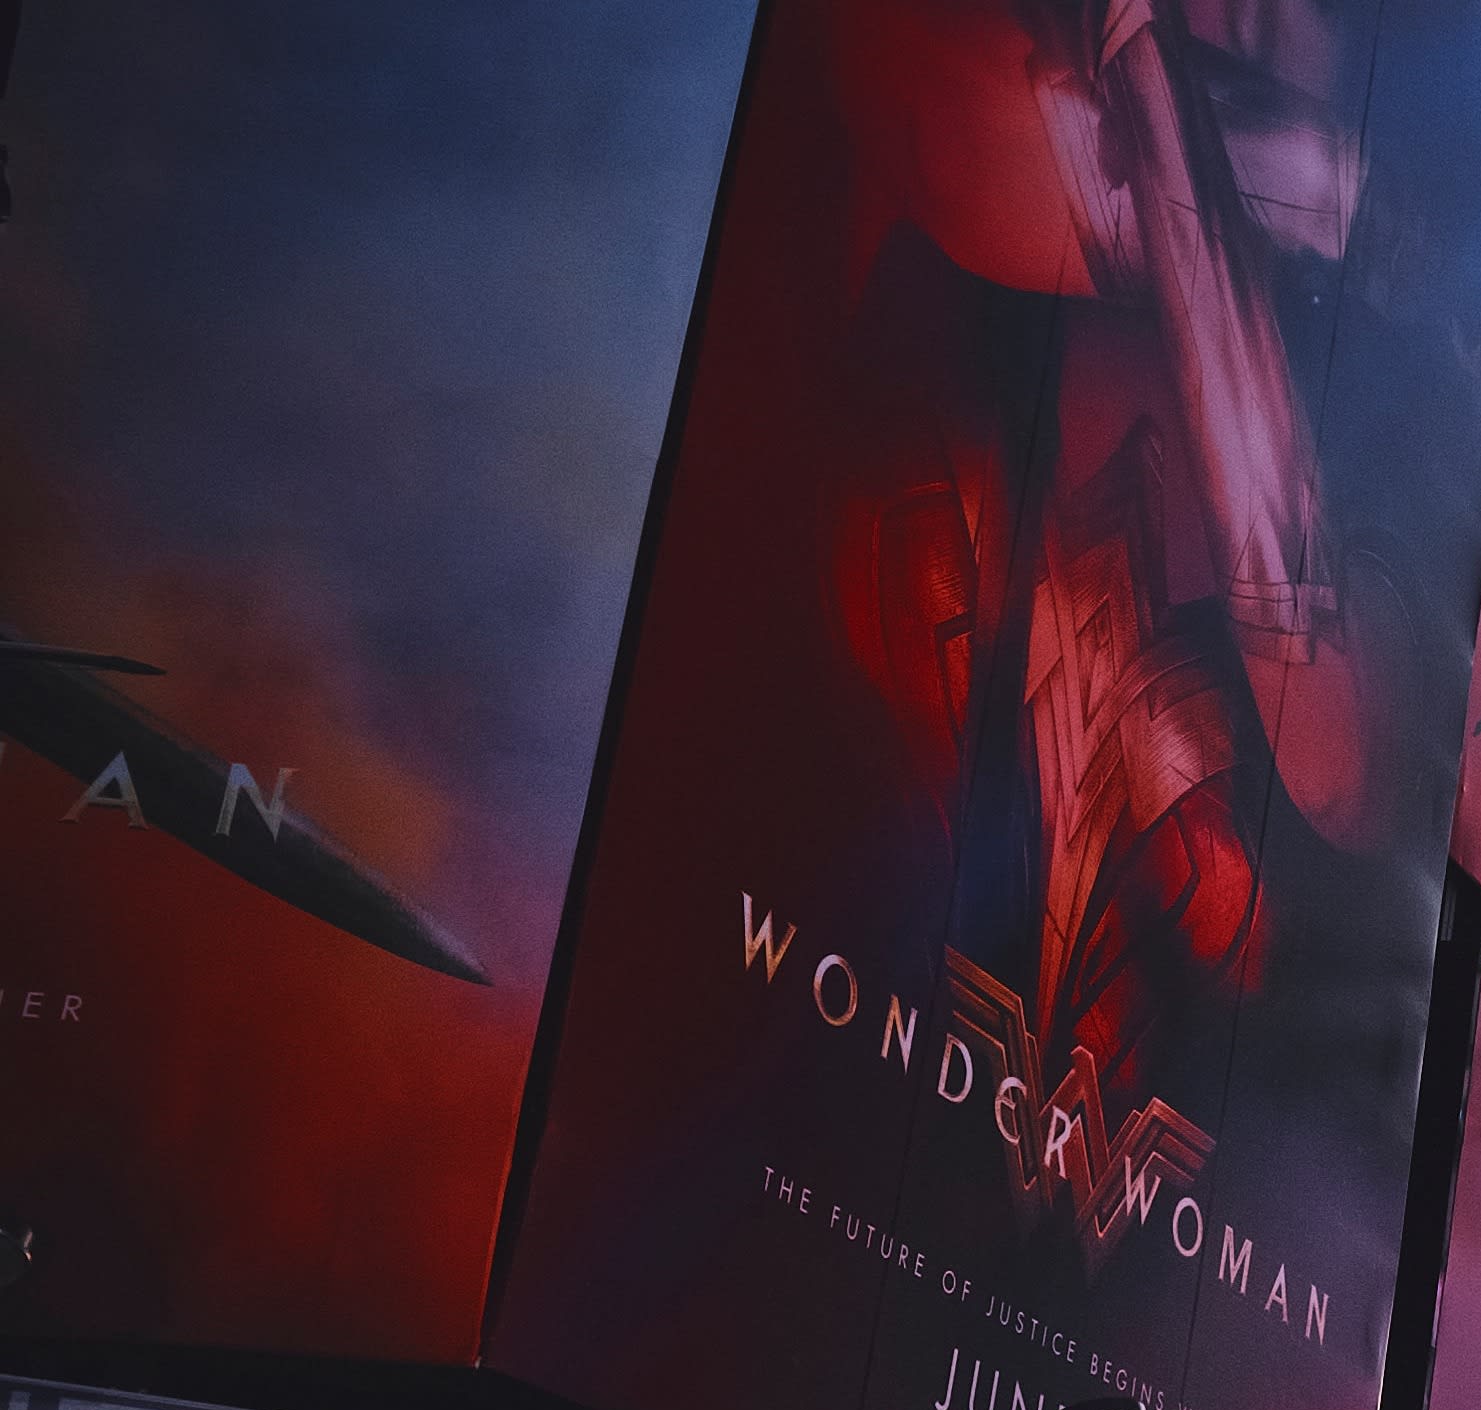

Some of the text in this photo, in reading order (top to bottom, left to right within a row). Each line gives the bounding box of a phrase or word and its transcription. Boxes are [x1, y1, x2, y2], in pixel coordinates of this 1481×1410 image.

[0, 741, 298, 844] AN
[0, 988, 84, 1023] ER
[740, 890, 1330, 1347] WONDER WOMAN
[761, 1164, 811, 1215] THE
[829, 1203, 926, 1279] FUTURE
[940, 1269, 973, 1303] OF
[984, 1295, 1078, 1365] JUSTICE
